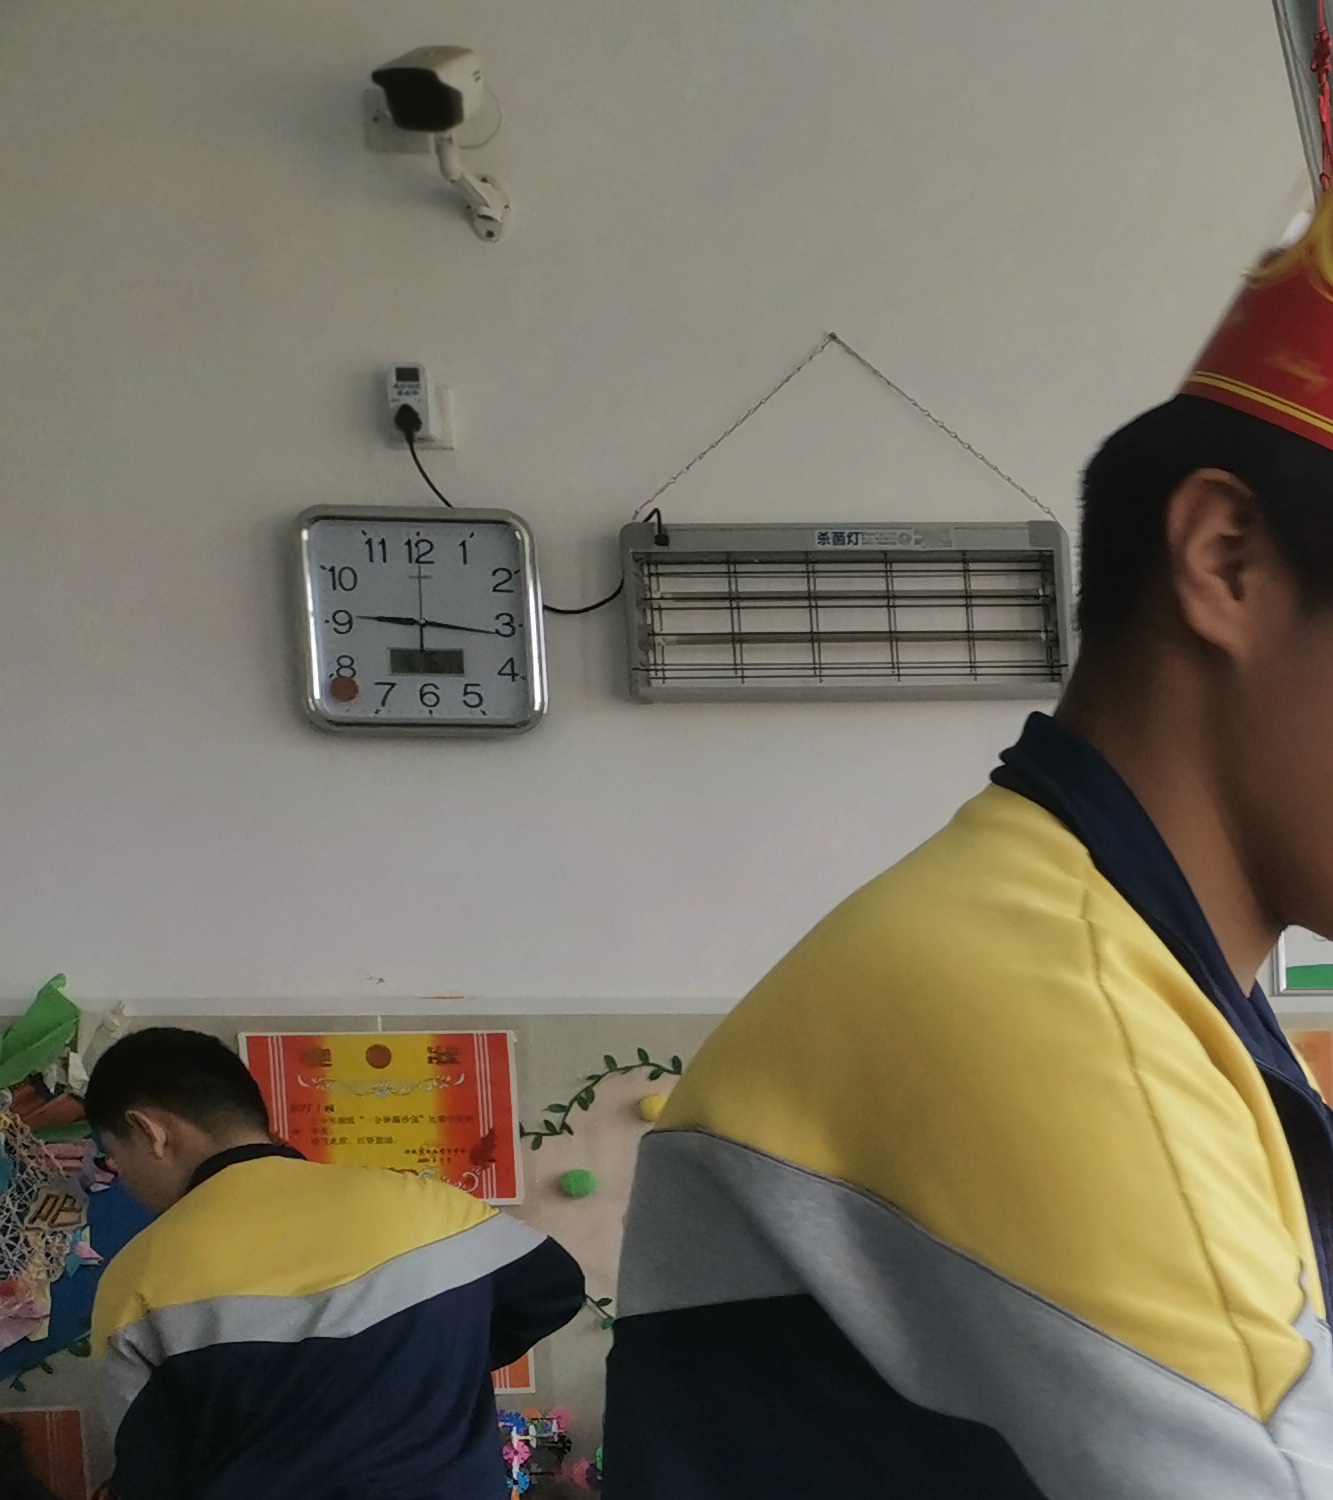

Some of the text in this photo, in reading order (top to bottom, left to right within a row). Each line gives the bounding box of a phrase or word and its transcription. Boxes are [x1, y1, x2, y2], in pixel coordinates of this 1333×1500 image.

[364, 537, 387, 564] 11
[404, 538, 435, 565] 12
[458, 539, 468, 565] 1
[327, 566, 358, 592] 10
[491, 567, 515, 593] 2
[331, 609, 354, 635] 9
[494, 612, 516, 638] 3
[335, 655, 357, 679] 8
[496, 657, 519, 682] 4
[373, 681, 397, 707] 7
[419, 683, 440, 708] 6
[462, 683, 483, 708] 5
